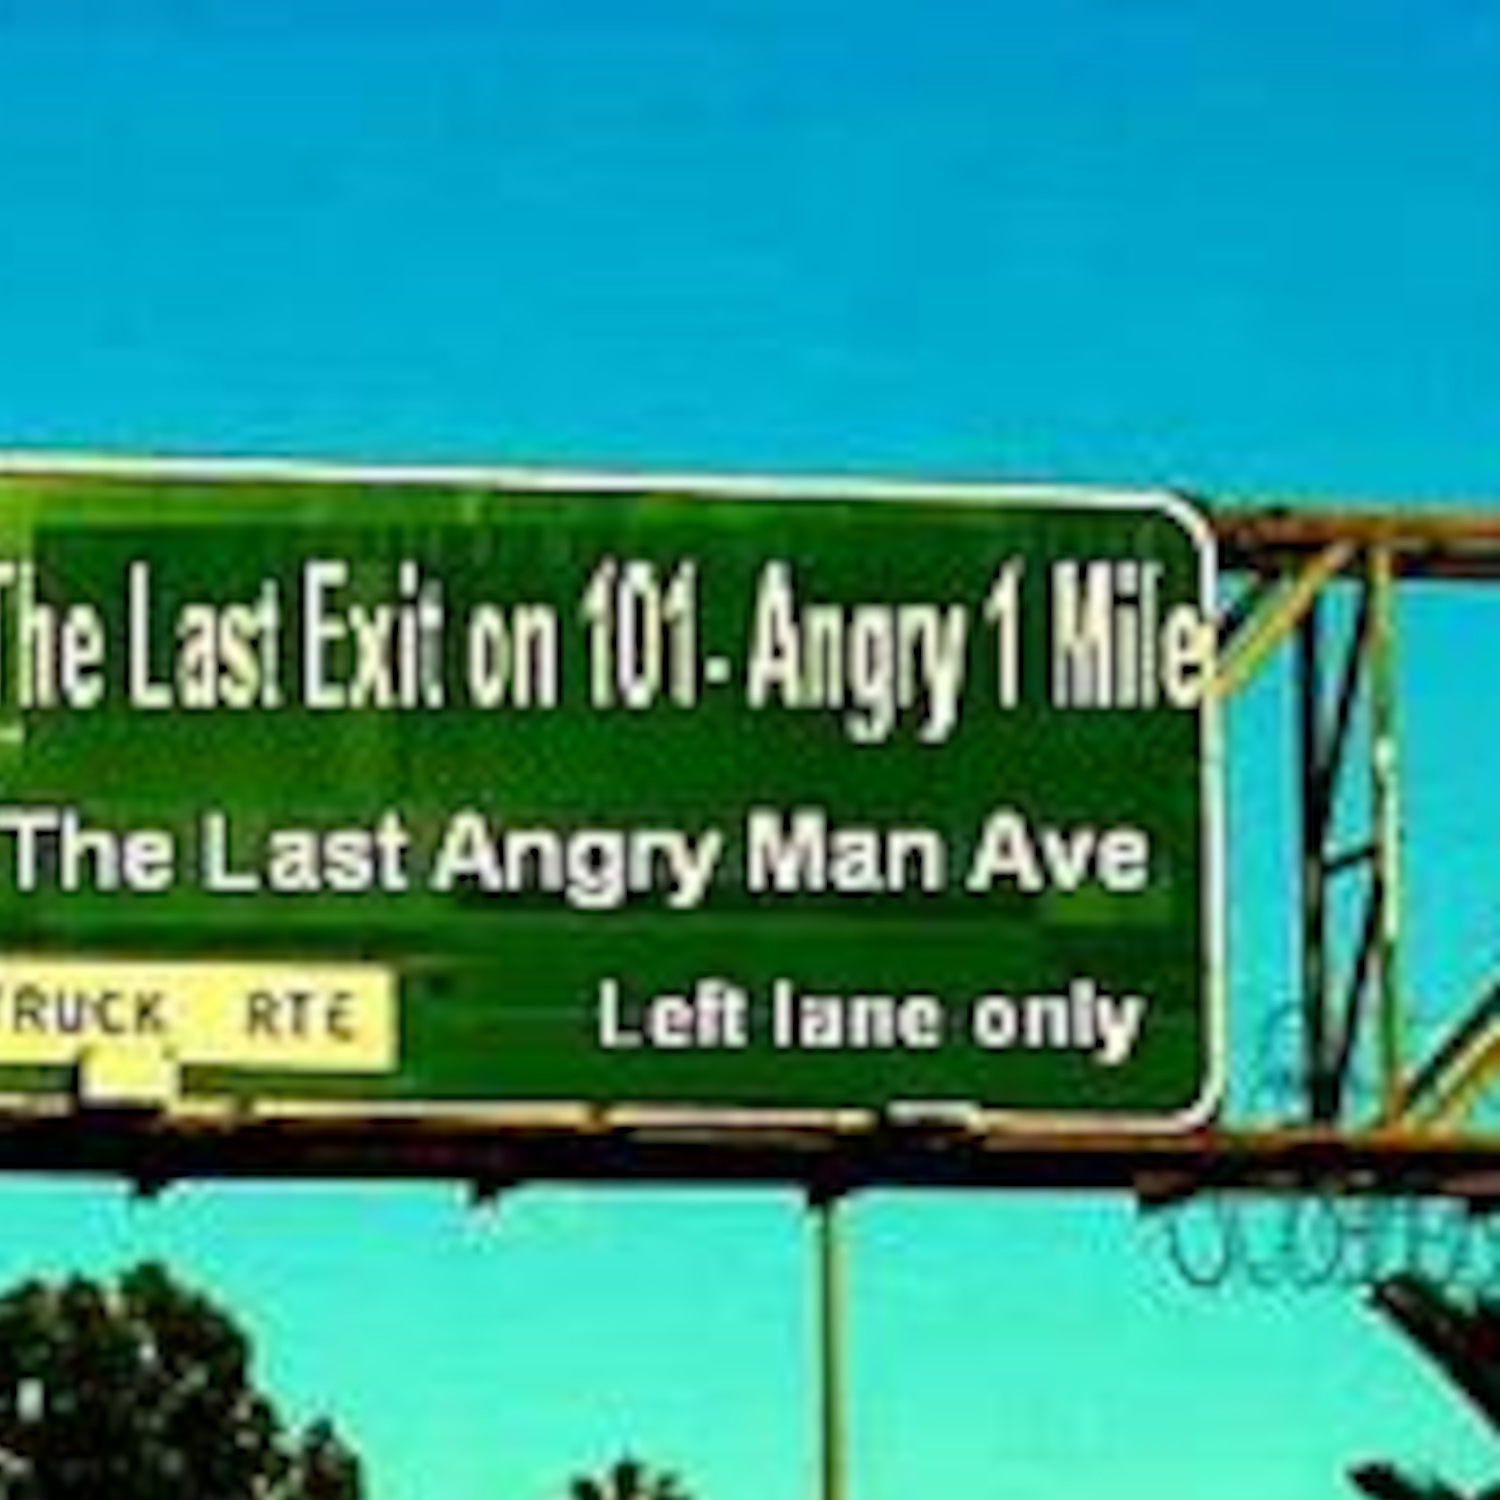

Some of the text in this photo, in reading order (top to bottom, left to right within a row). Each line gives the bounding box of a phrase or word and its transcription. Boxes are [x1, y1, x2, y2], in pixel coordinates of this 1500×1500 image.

[129, 558, 281, 709] Last
[304, 558, 446, 709] Exit
[466, 602, 558, 709] on
[746, 558, 967, 743] Angry
[984, 558, 1022, 709] 1
[1051, 558, 1215, 709] Mile
[204, 807, 409, 892] Last
[430, 810, 722, 909] Angry
[747, 810, 945, 893] Man
[966, 810, 1150, 893] Ave
[244, 990, 357, 1042] RTE
[598, 978, 1147, 1065] Left lane only
